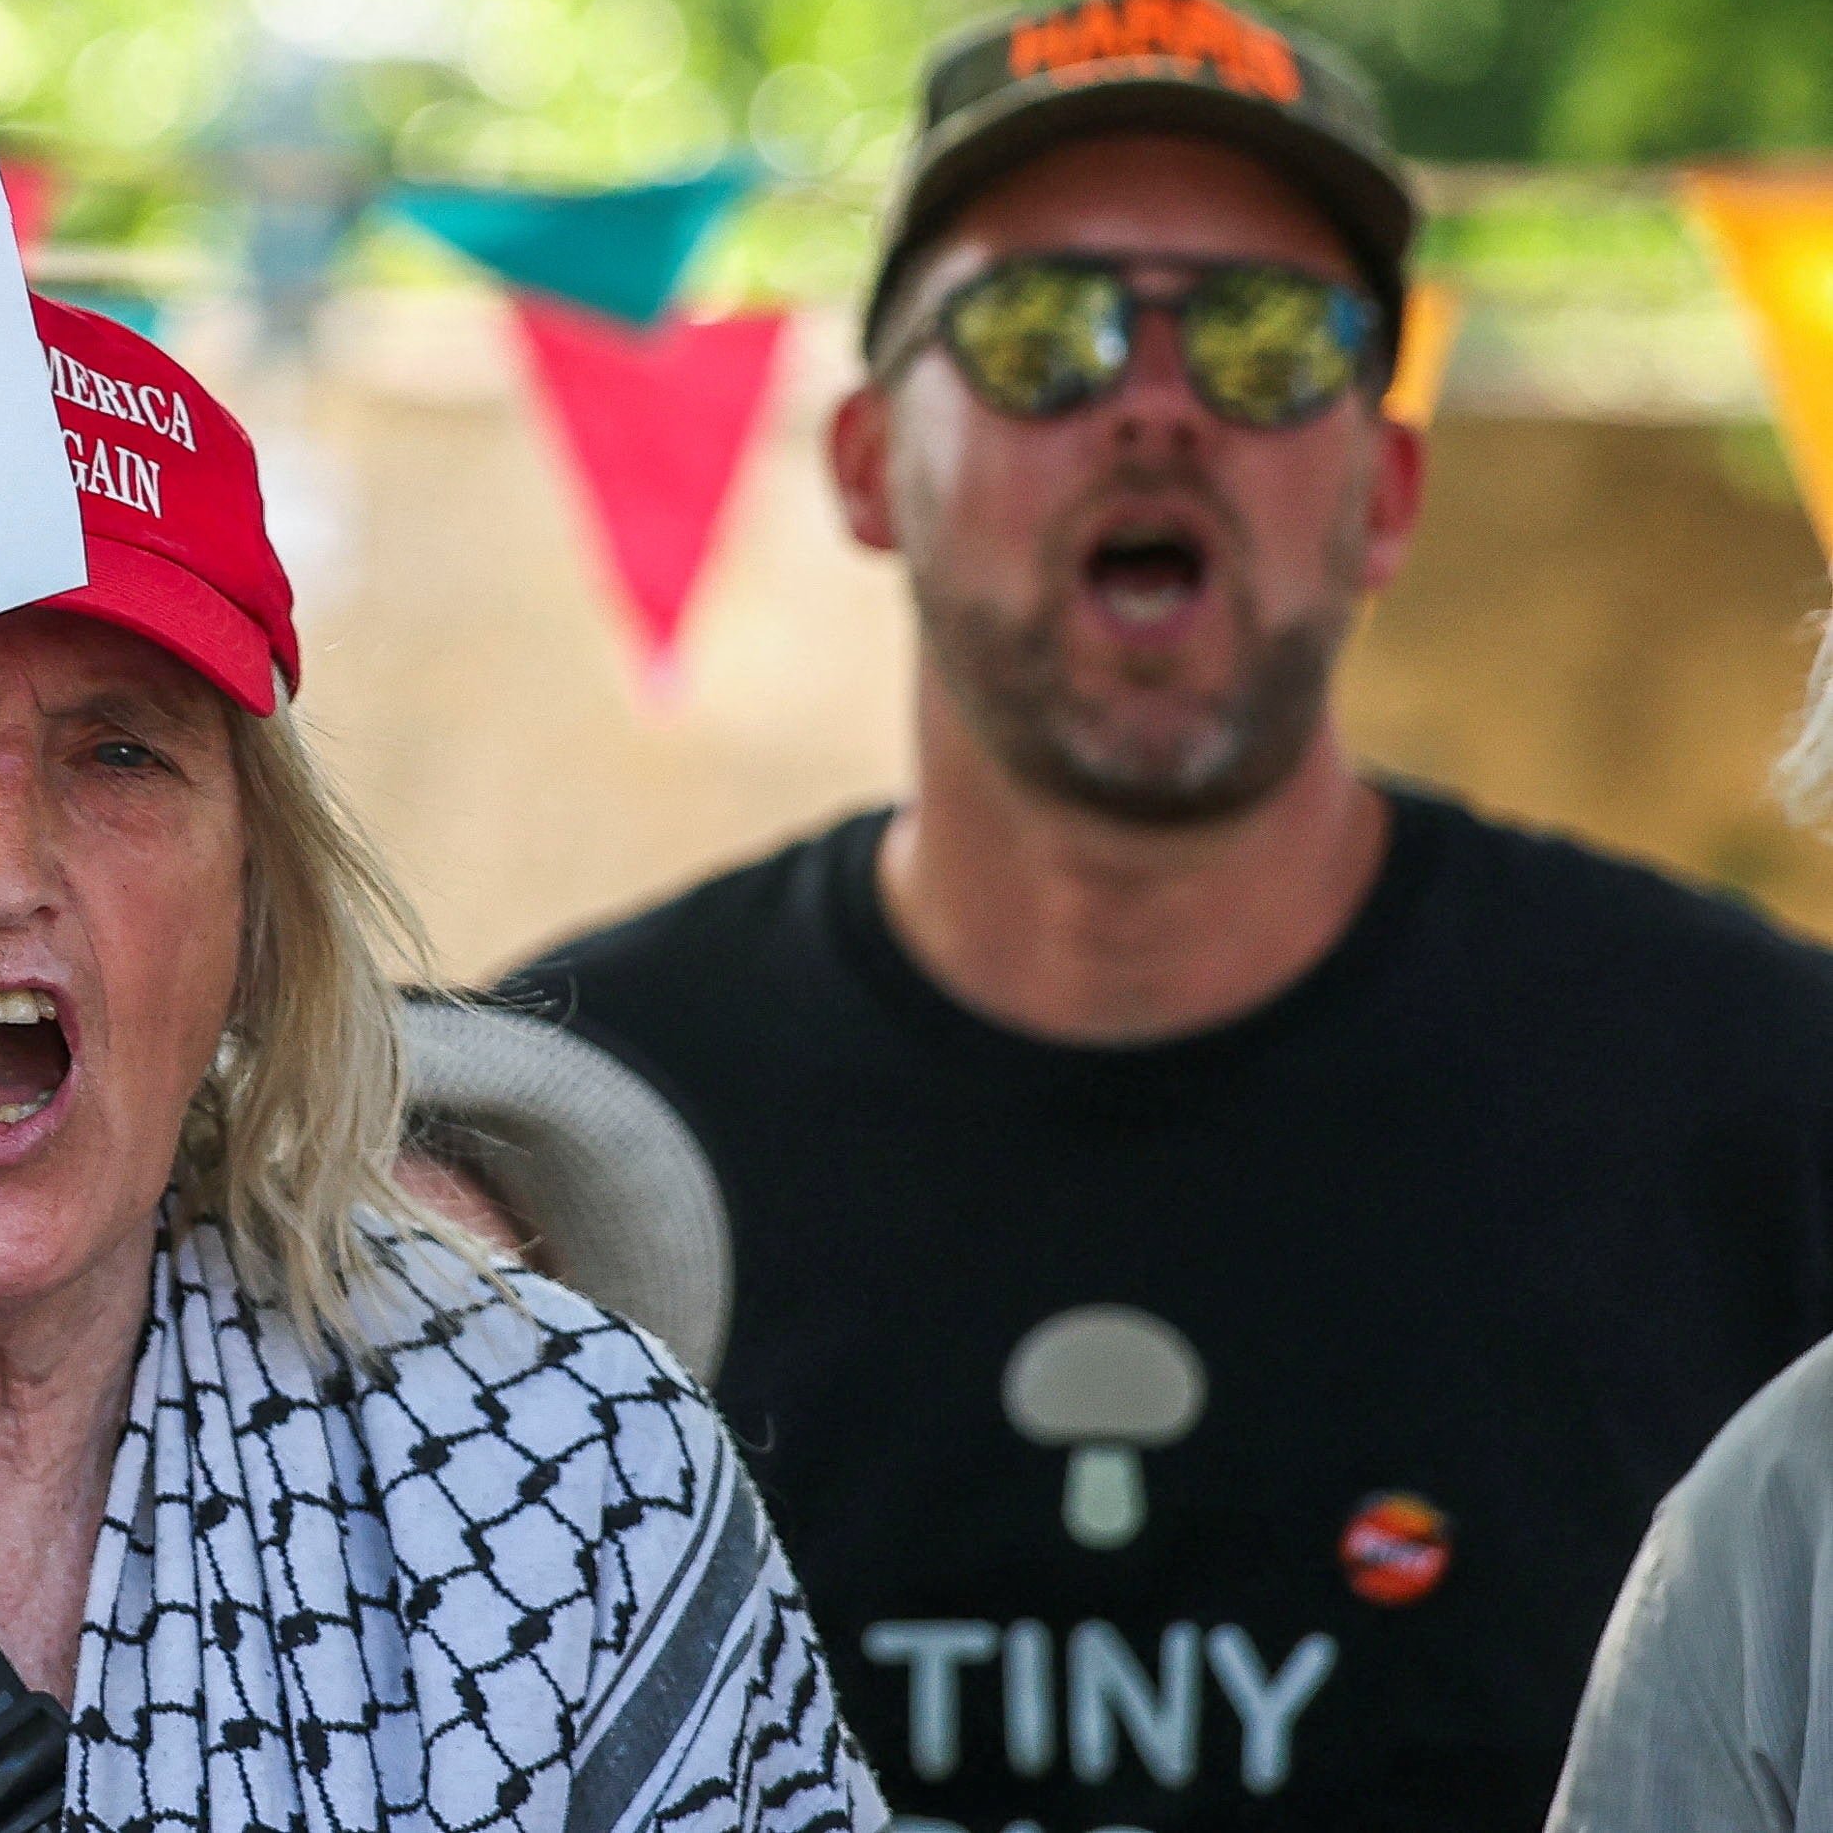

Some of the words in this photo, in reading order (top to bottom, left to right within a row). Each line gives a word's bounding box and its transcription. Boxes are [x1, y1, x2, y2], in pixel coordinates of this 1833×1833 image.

[47, 344, 198, 454] MERICA
[60, 427, 164, 520] GAIN
[860, 1615, 1340, 1796] TINY
